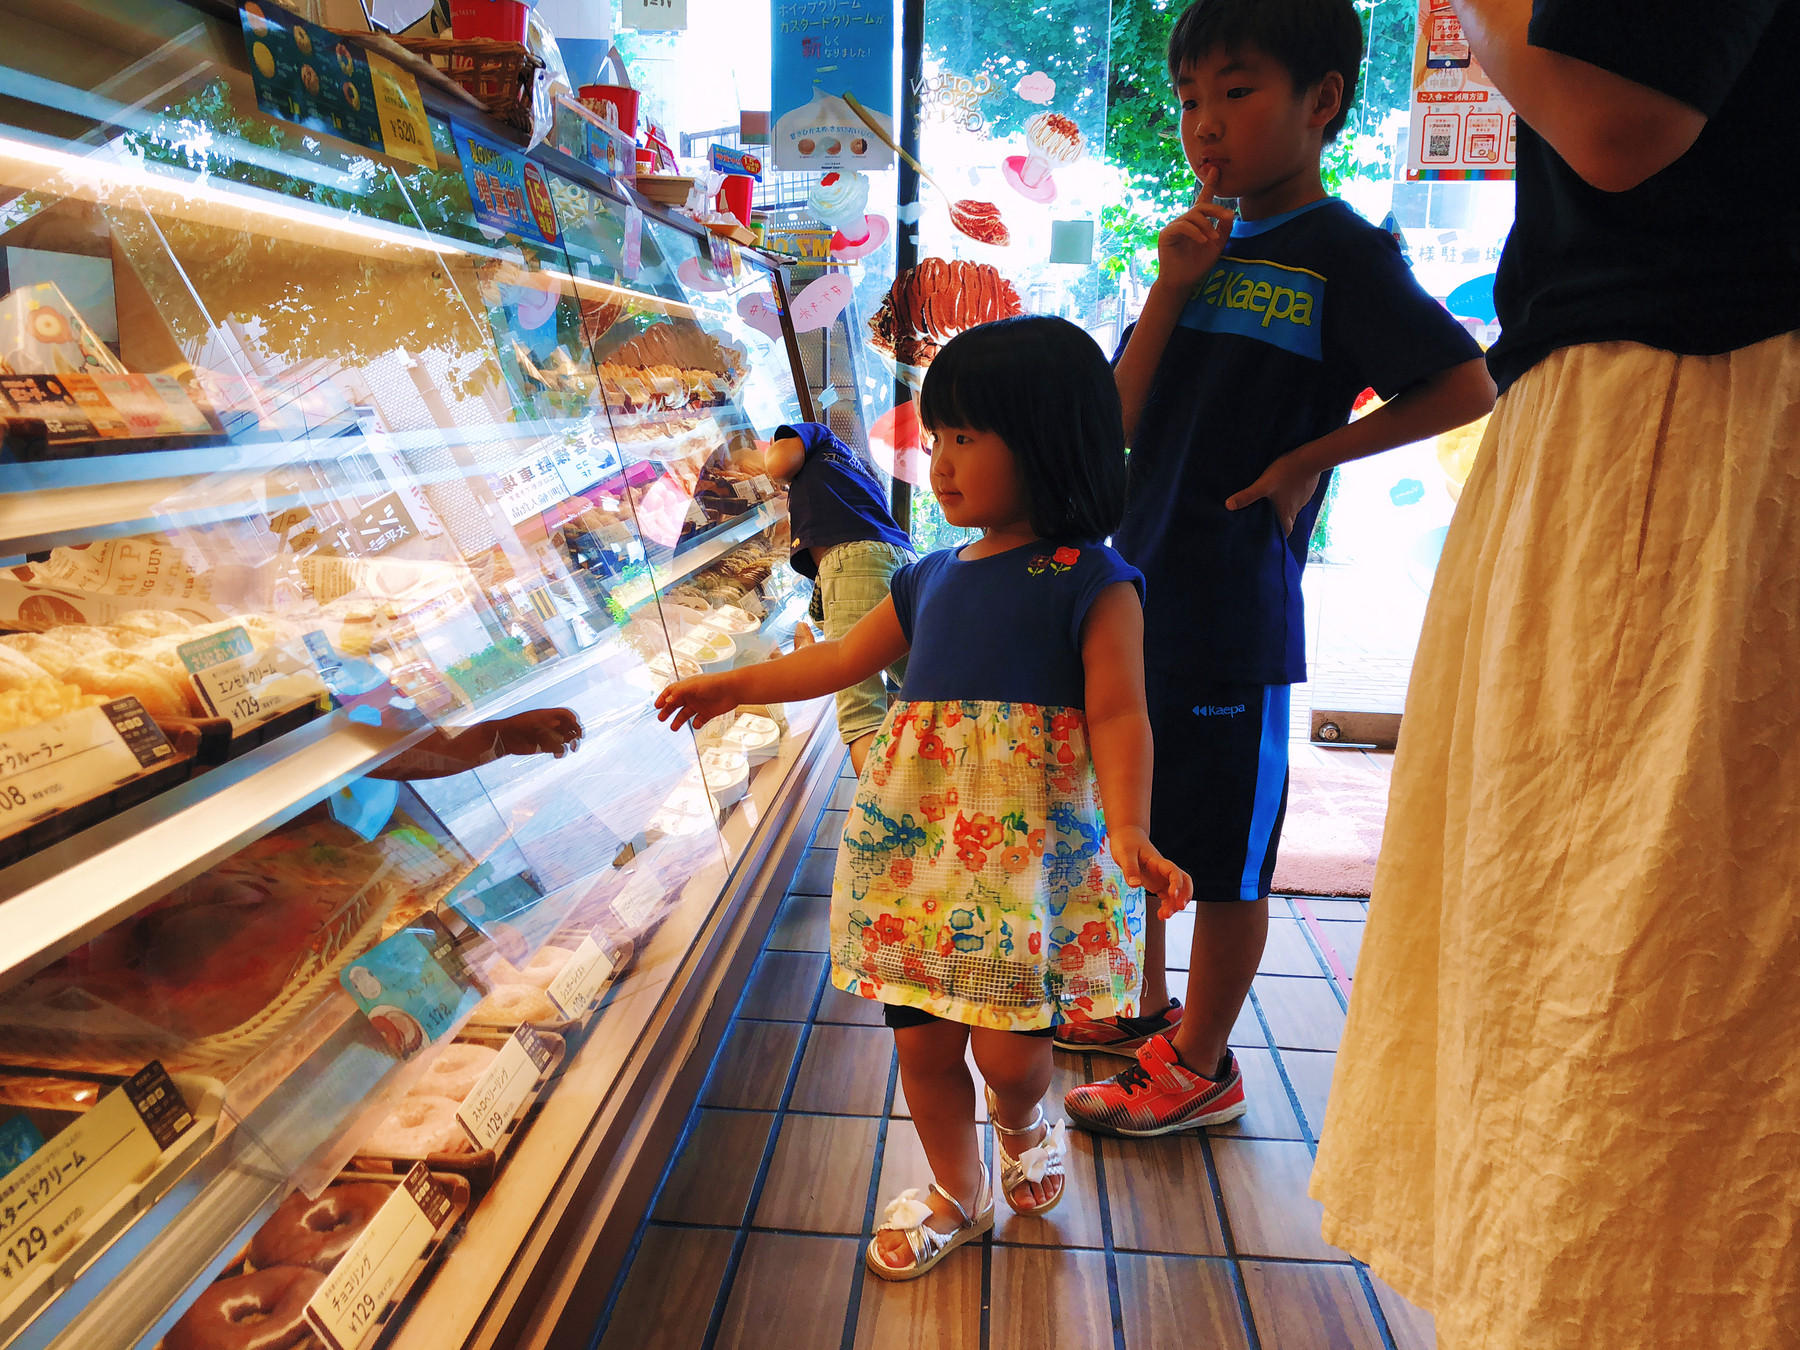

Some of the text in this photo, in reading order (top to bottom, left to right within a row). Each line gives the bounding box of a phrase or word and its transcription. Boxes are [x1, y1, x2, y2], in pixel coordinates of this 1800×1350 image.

[390, 119, 416, 145] ¥520
[1217, 272, 1314, 328] Kaepa
[231, 696, 260, 720] ¥129
[1208, 703, 1246, 718] Kaepa
[485, 1112, 504, 1140] ¥129
[0, 1226, 48, 1279] ¥129
[331, 1254, 373, 1312] チョコリング
[349, 1293, 376, 1335] ¥129
